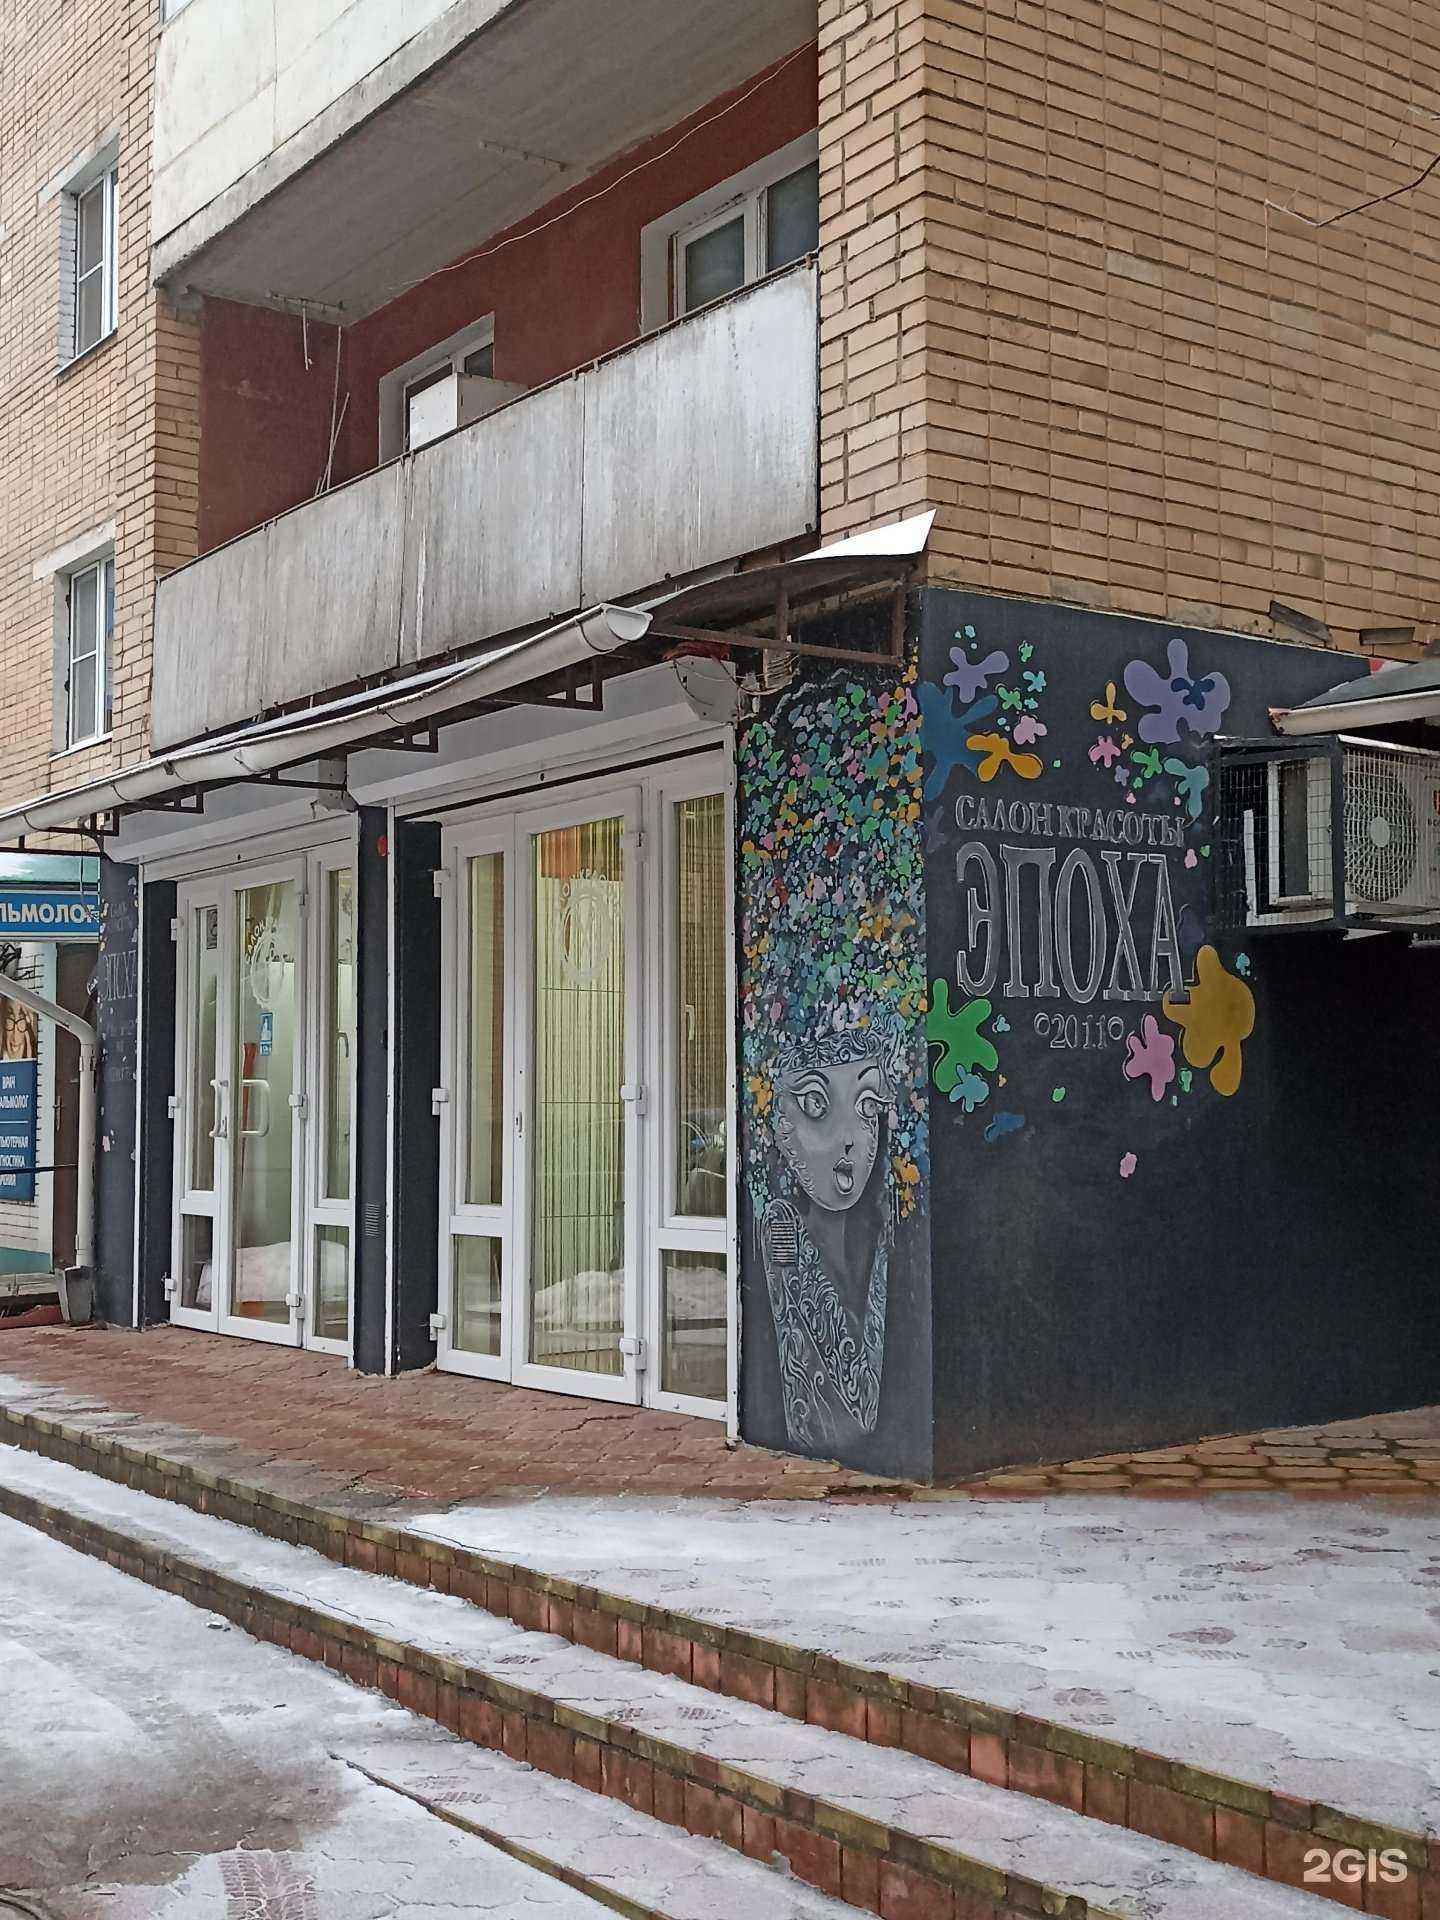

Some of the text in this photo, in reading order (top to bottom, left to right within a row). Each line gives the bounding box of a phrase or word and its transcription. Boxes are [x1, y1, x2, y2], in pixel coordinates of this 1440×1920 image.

[955, 795, 1186, 848] САЛОН КРАСОТЫ
[956, 841, 1191, 1005] ЭПОХА
